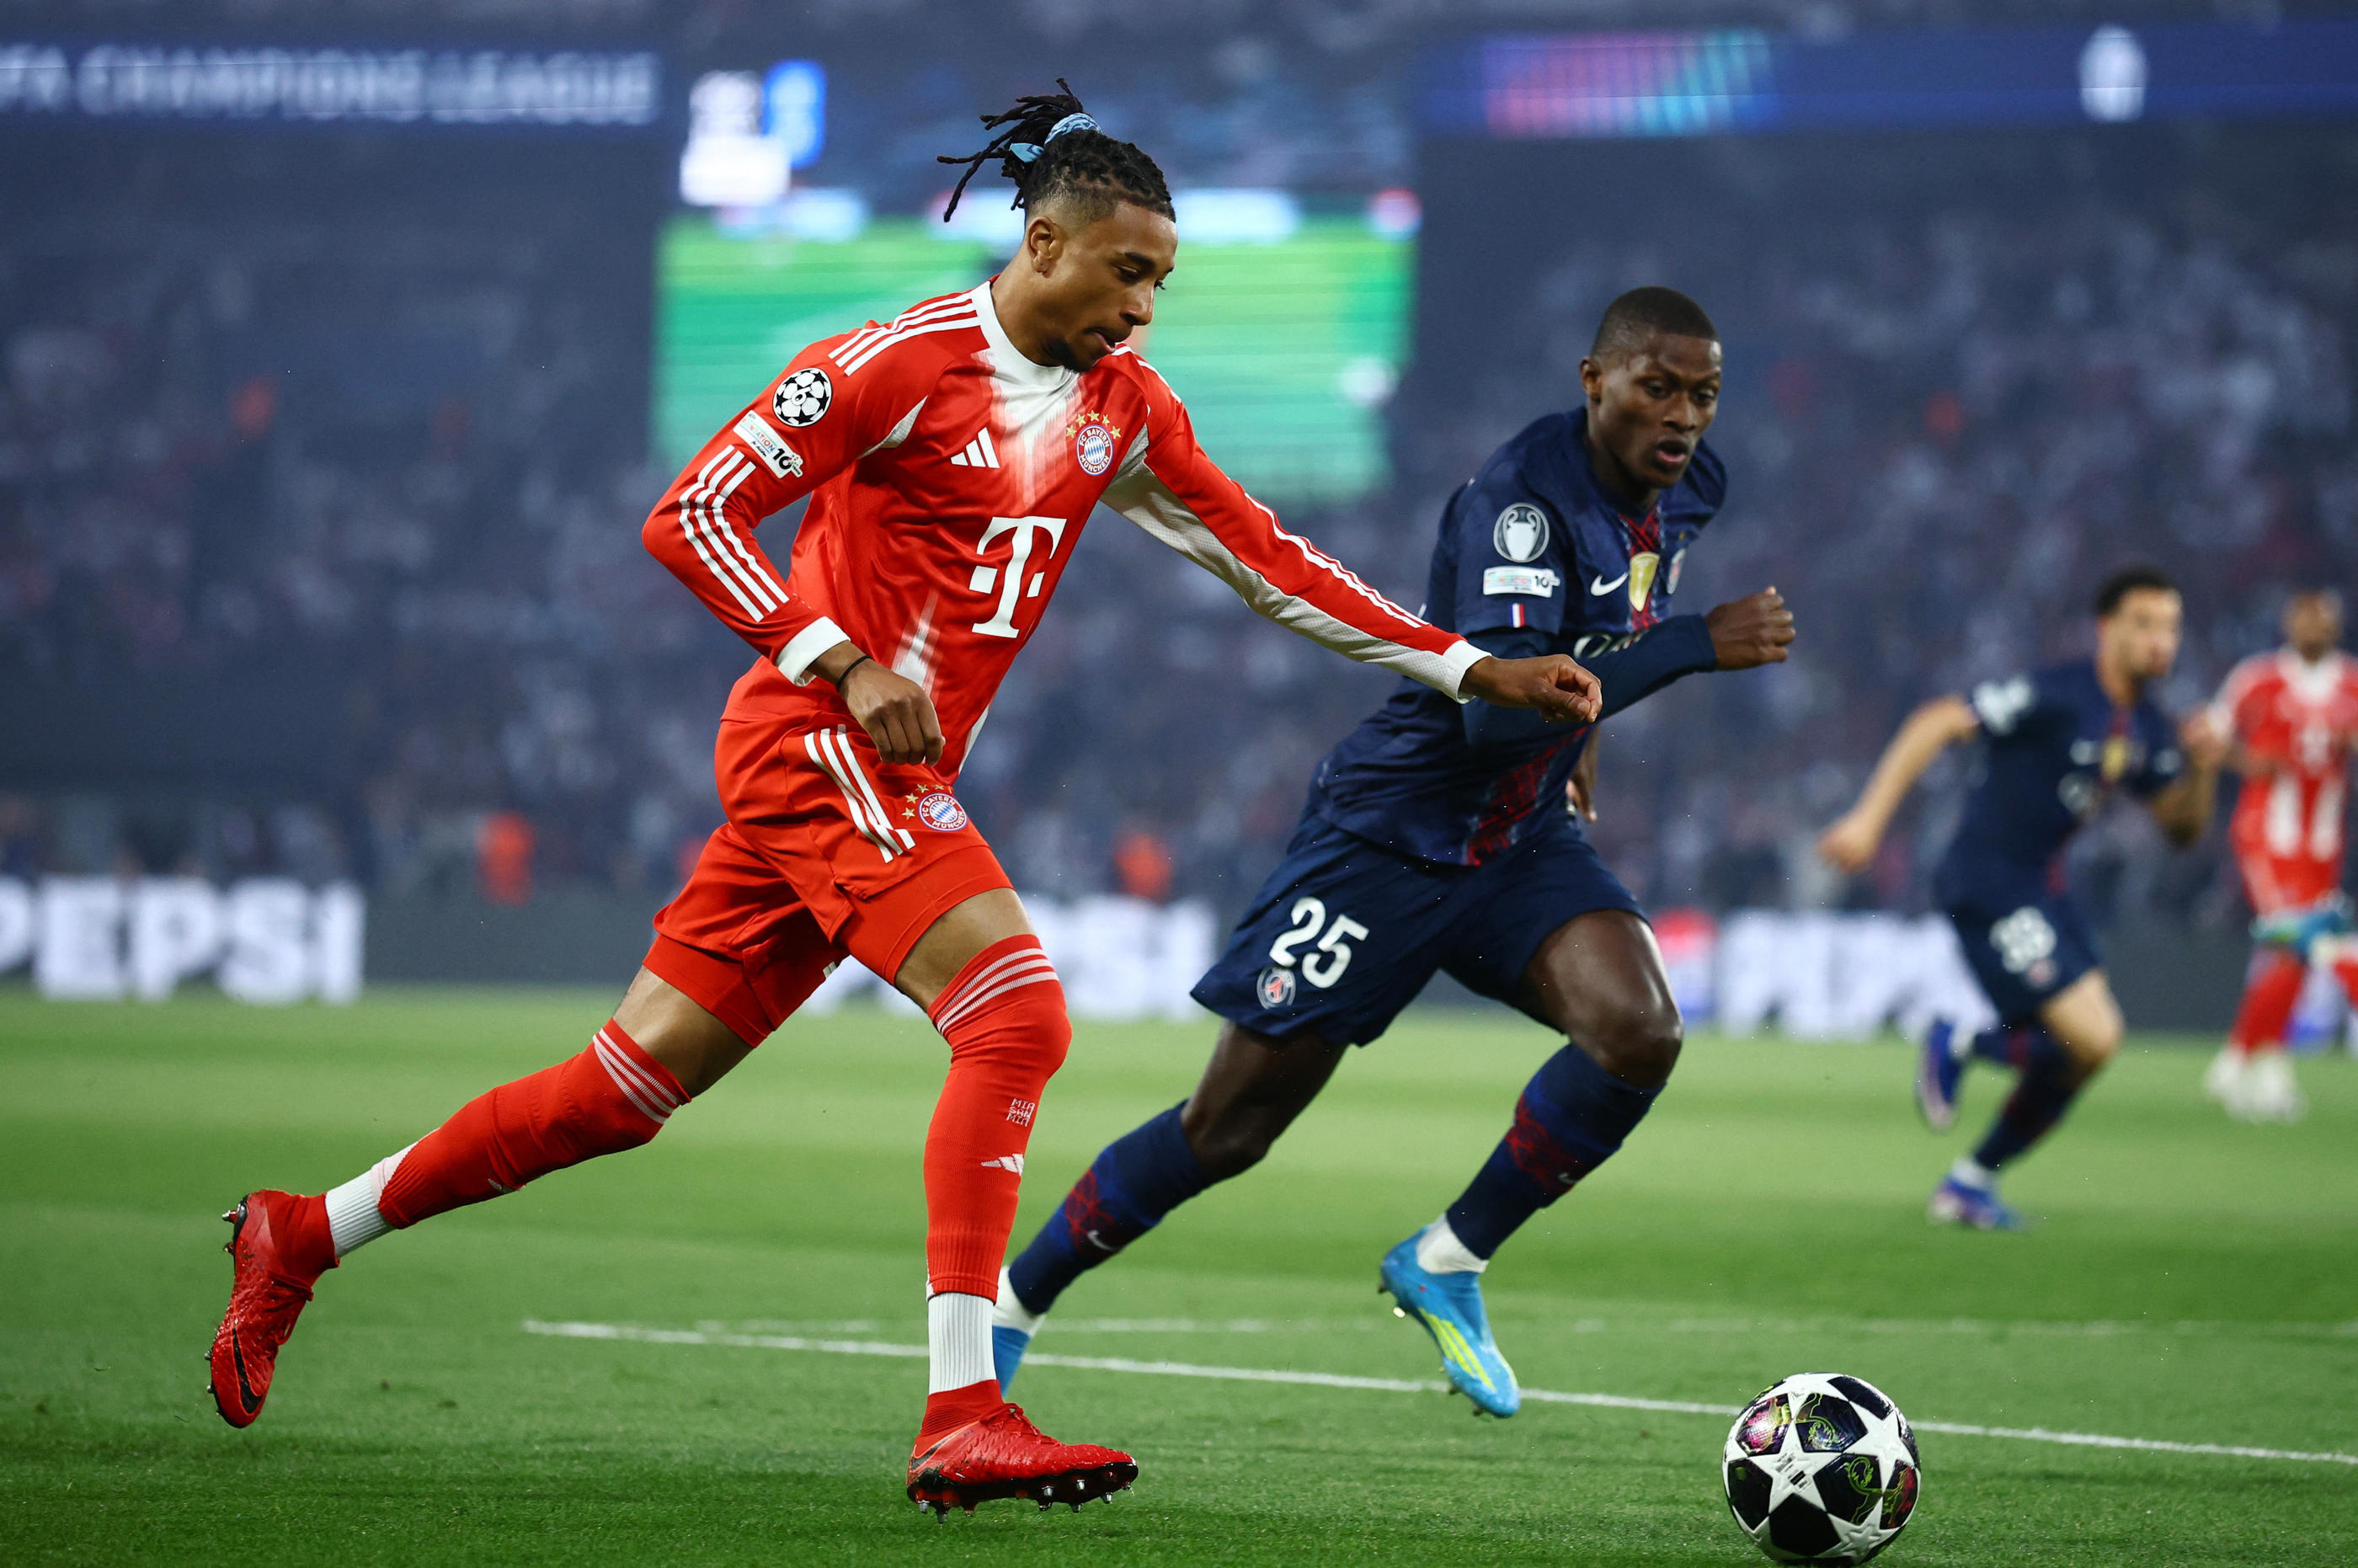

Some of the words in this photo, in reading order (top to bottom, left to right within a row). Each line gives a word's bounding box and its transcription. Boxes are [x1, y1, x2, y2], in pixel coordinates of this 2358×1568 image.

[791, 386, 812, 406] 6
[741, 418, 776, 452] FNATION
[1079, 435, 1087, 447] FC
[1086, 428, 1111, 448] BAYERN
[772, 447, 794, 470] 10
[968, 515, 1068, 639] T
[924, 795, 956, 807] BAYERN
[921, 807, 931, 818] FC
[1268, 896, 1370, 989] 25
[1009, 1106, 1032, 1119] SAN
[1011, 1097, 1036, 1111] MIA
[1006, 1112, 1030, 1127] MIA
